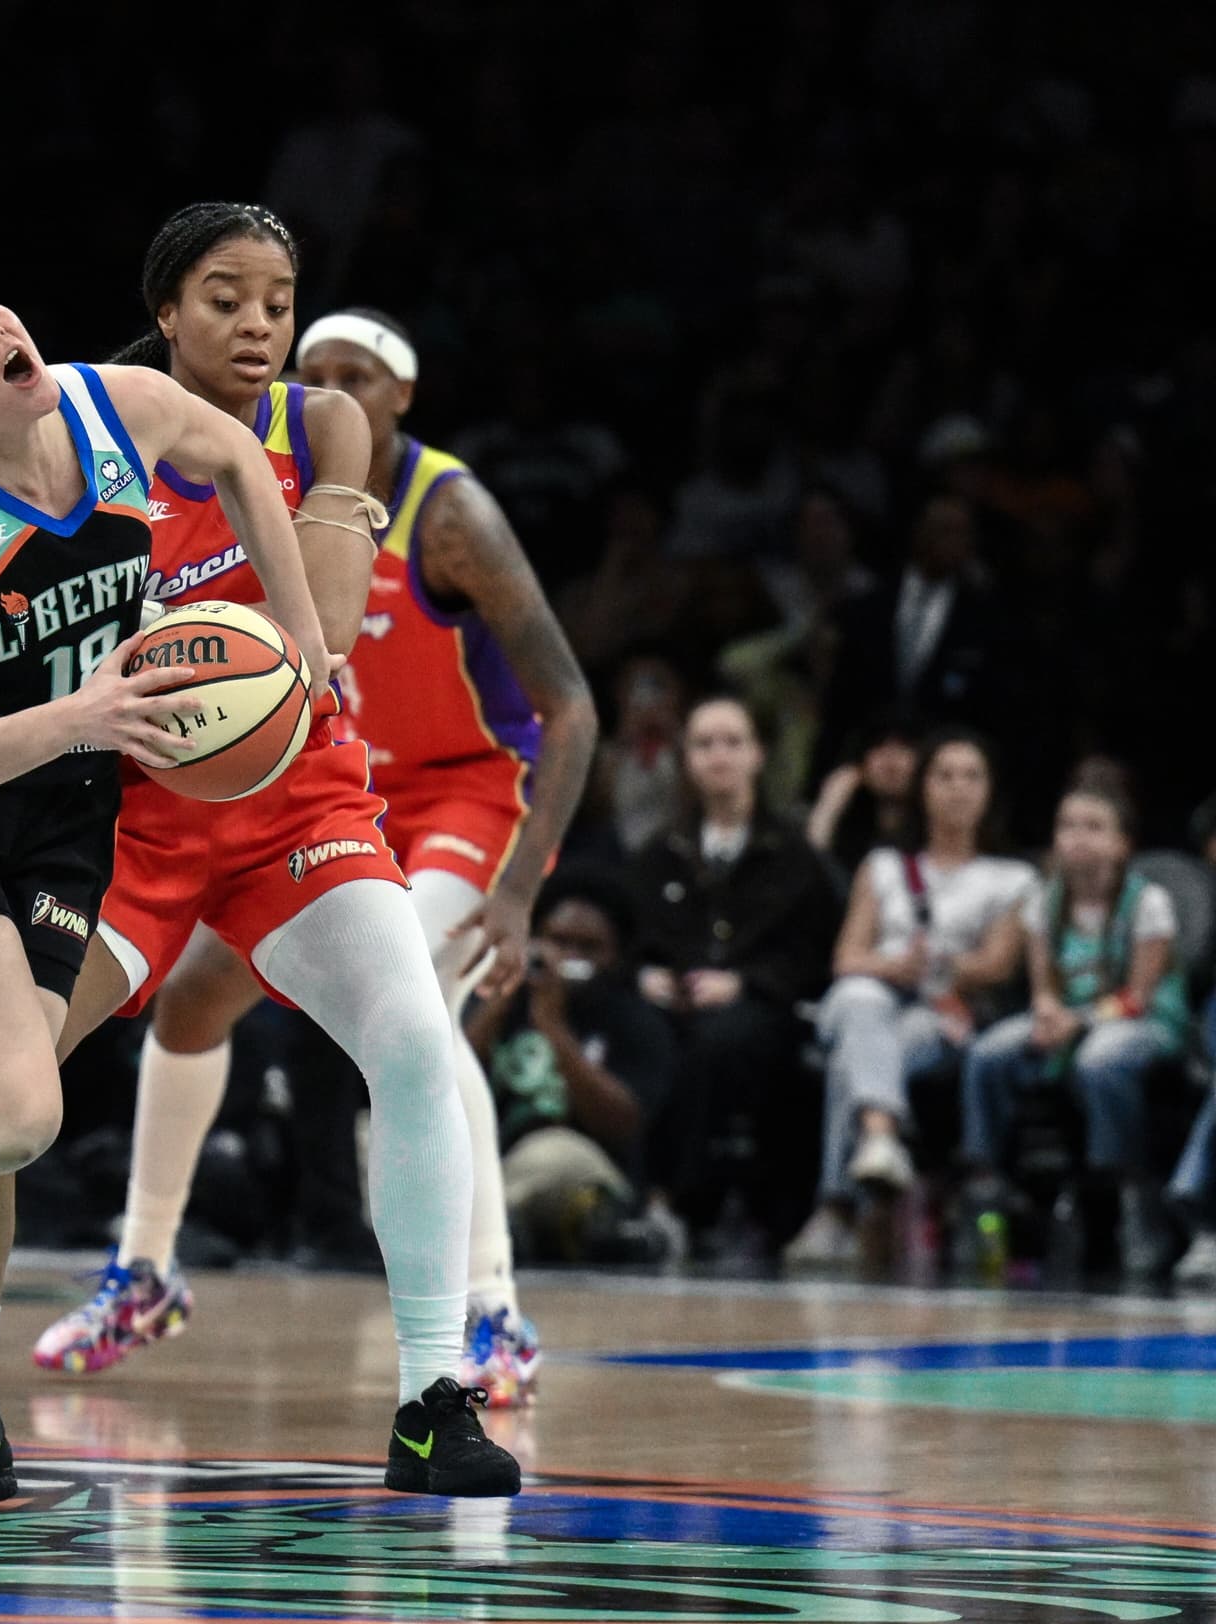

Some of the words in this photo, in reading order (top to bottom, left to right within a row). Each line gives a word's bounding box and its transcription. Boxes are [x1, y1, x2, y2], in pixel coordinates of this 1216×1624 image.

[102, 469, 135, 500] BARCLAYS
[147, 499, 170, 517] IKE
[43, 620, 121, 701] 18
[307, 840, 377, 866] WNBA
